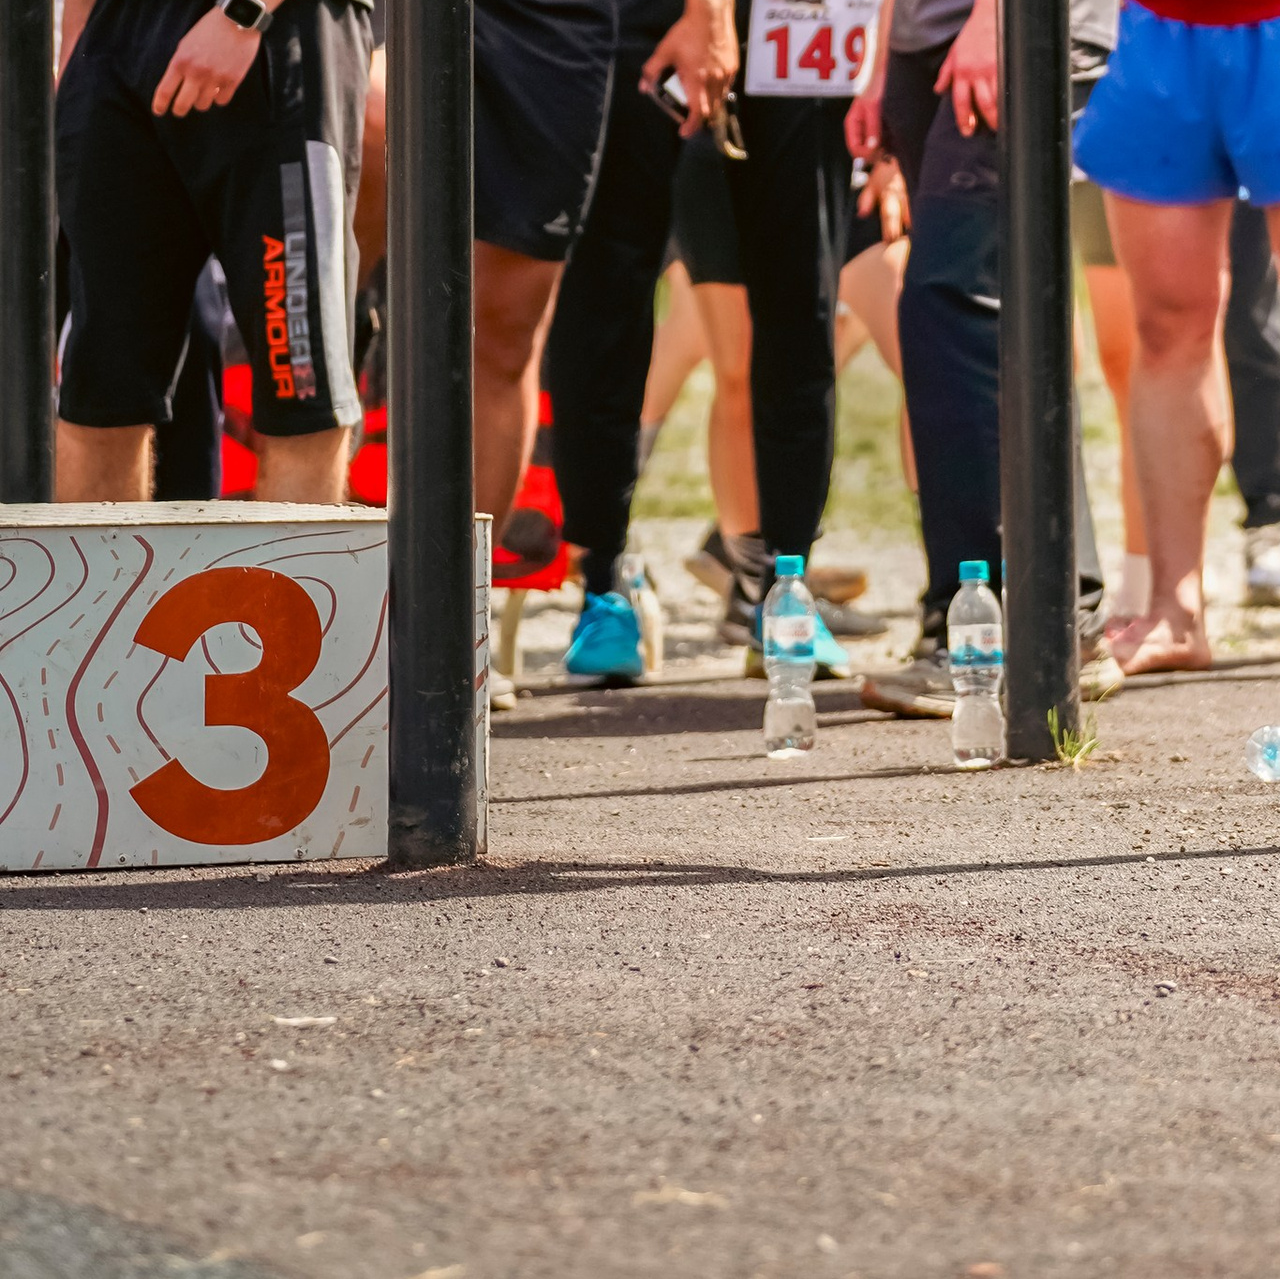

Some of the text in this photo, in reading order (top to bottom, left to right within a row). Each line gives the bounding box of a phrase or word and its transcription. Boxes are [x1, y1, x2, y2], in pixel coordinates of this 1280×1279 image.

[765, 24, 867, 81] 149
[262, 235, 296, 399] ARMOUR
[129, 565, 331, 846] 3
